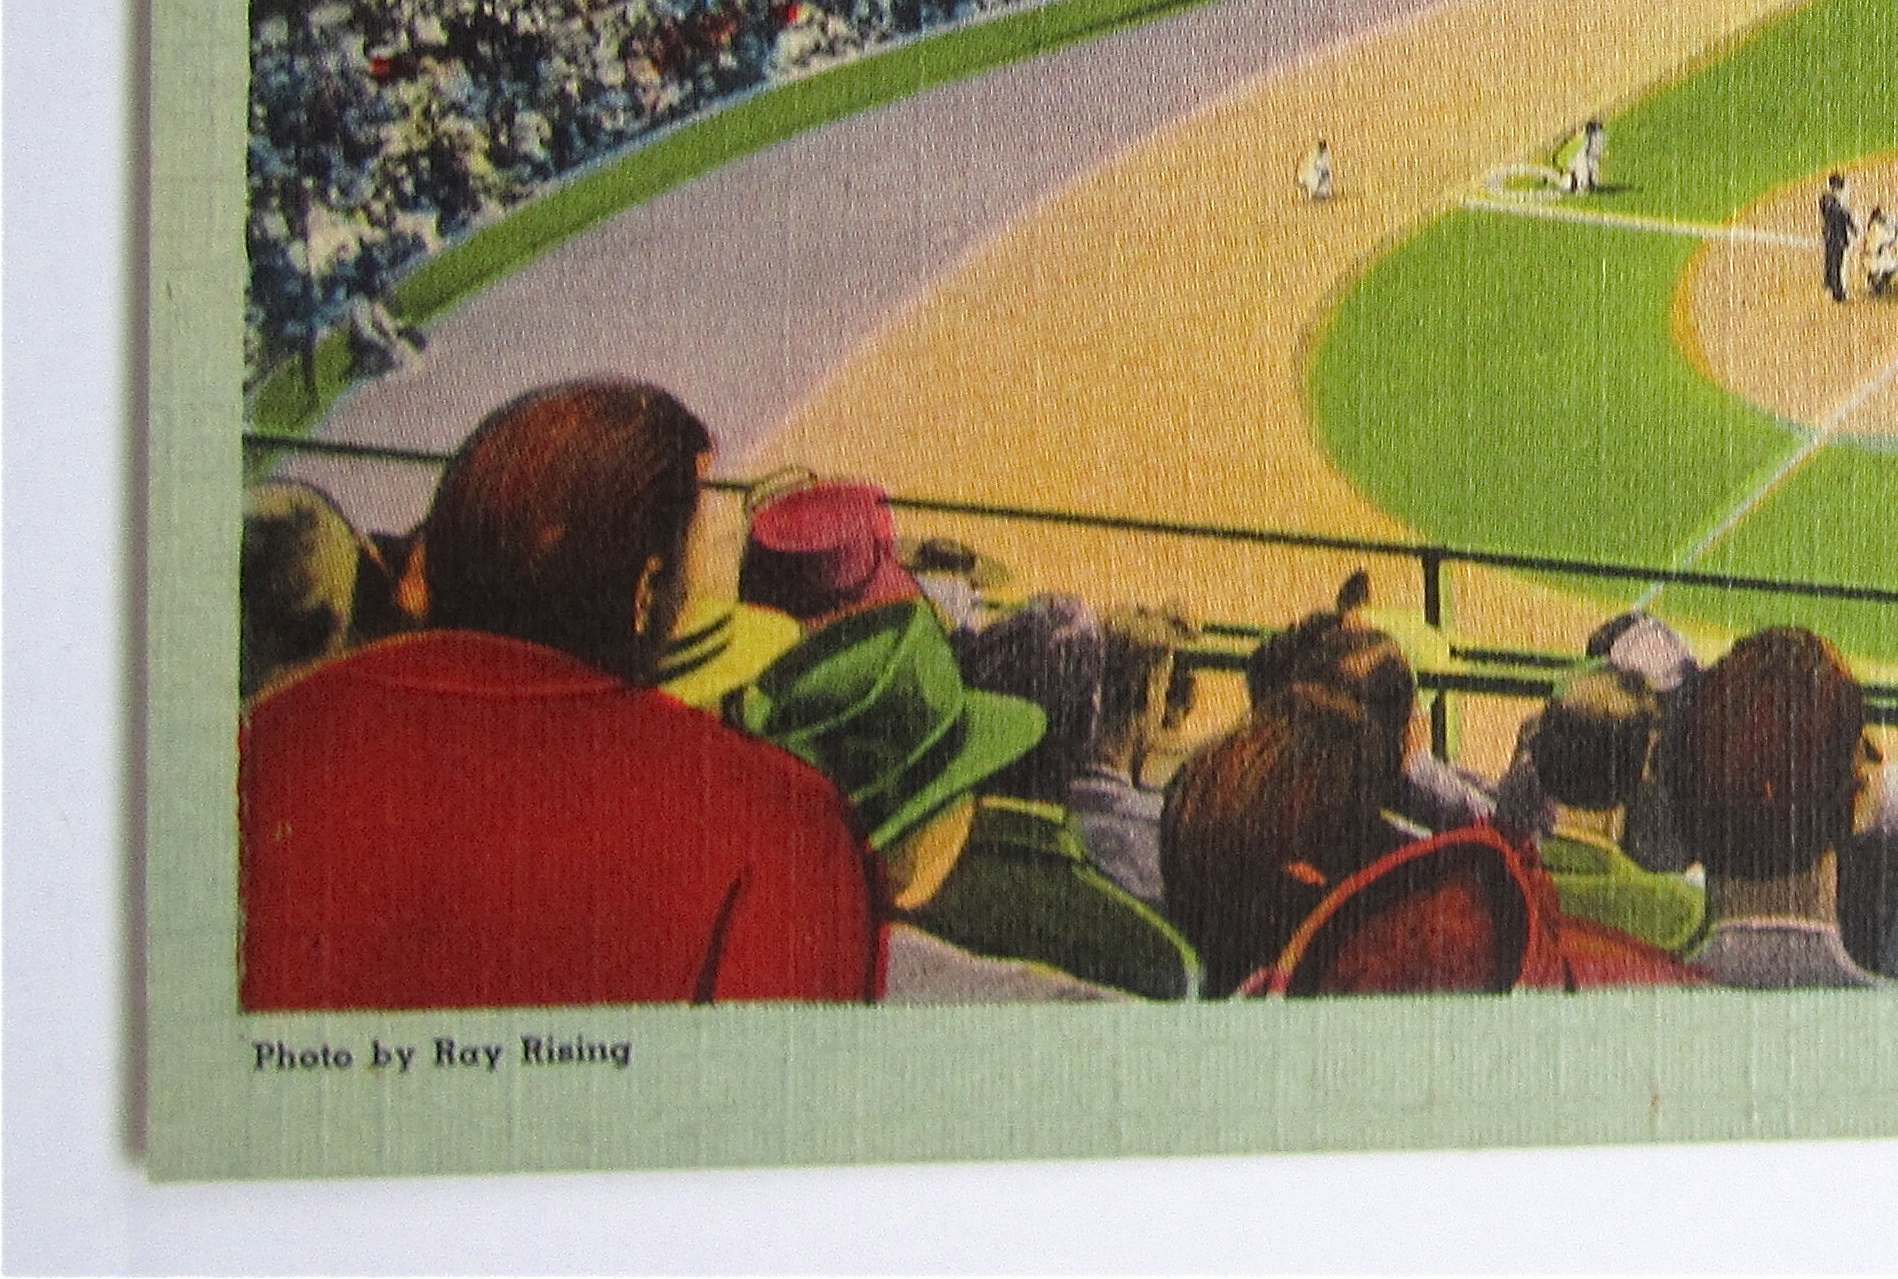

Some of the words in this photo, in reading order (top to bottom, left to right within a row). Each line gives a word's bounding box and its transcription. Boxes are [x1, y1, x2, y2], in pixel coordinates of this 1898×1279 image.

[253, 1038, 355, 1072] Photo
[371, 1037, 416, 1073] by
[433, 1035, 502, 1072] Ray
[521, 1033, 634, 1071] Rising
